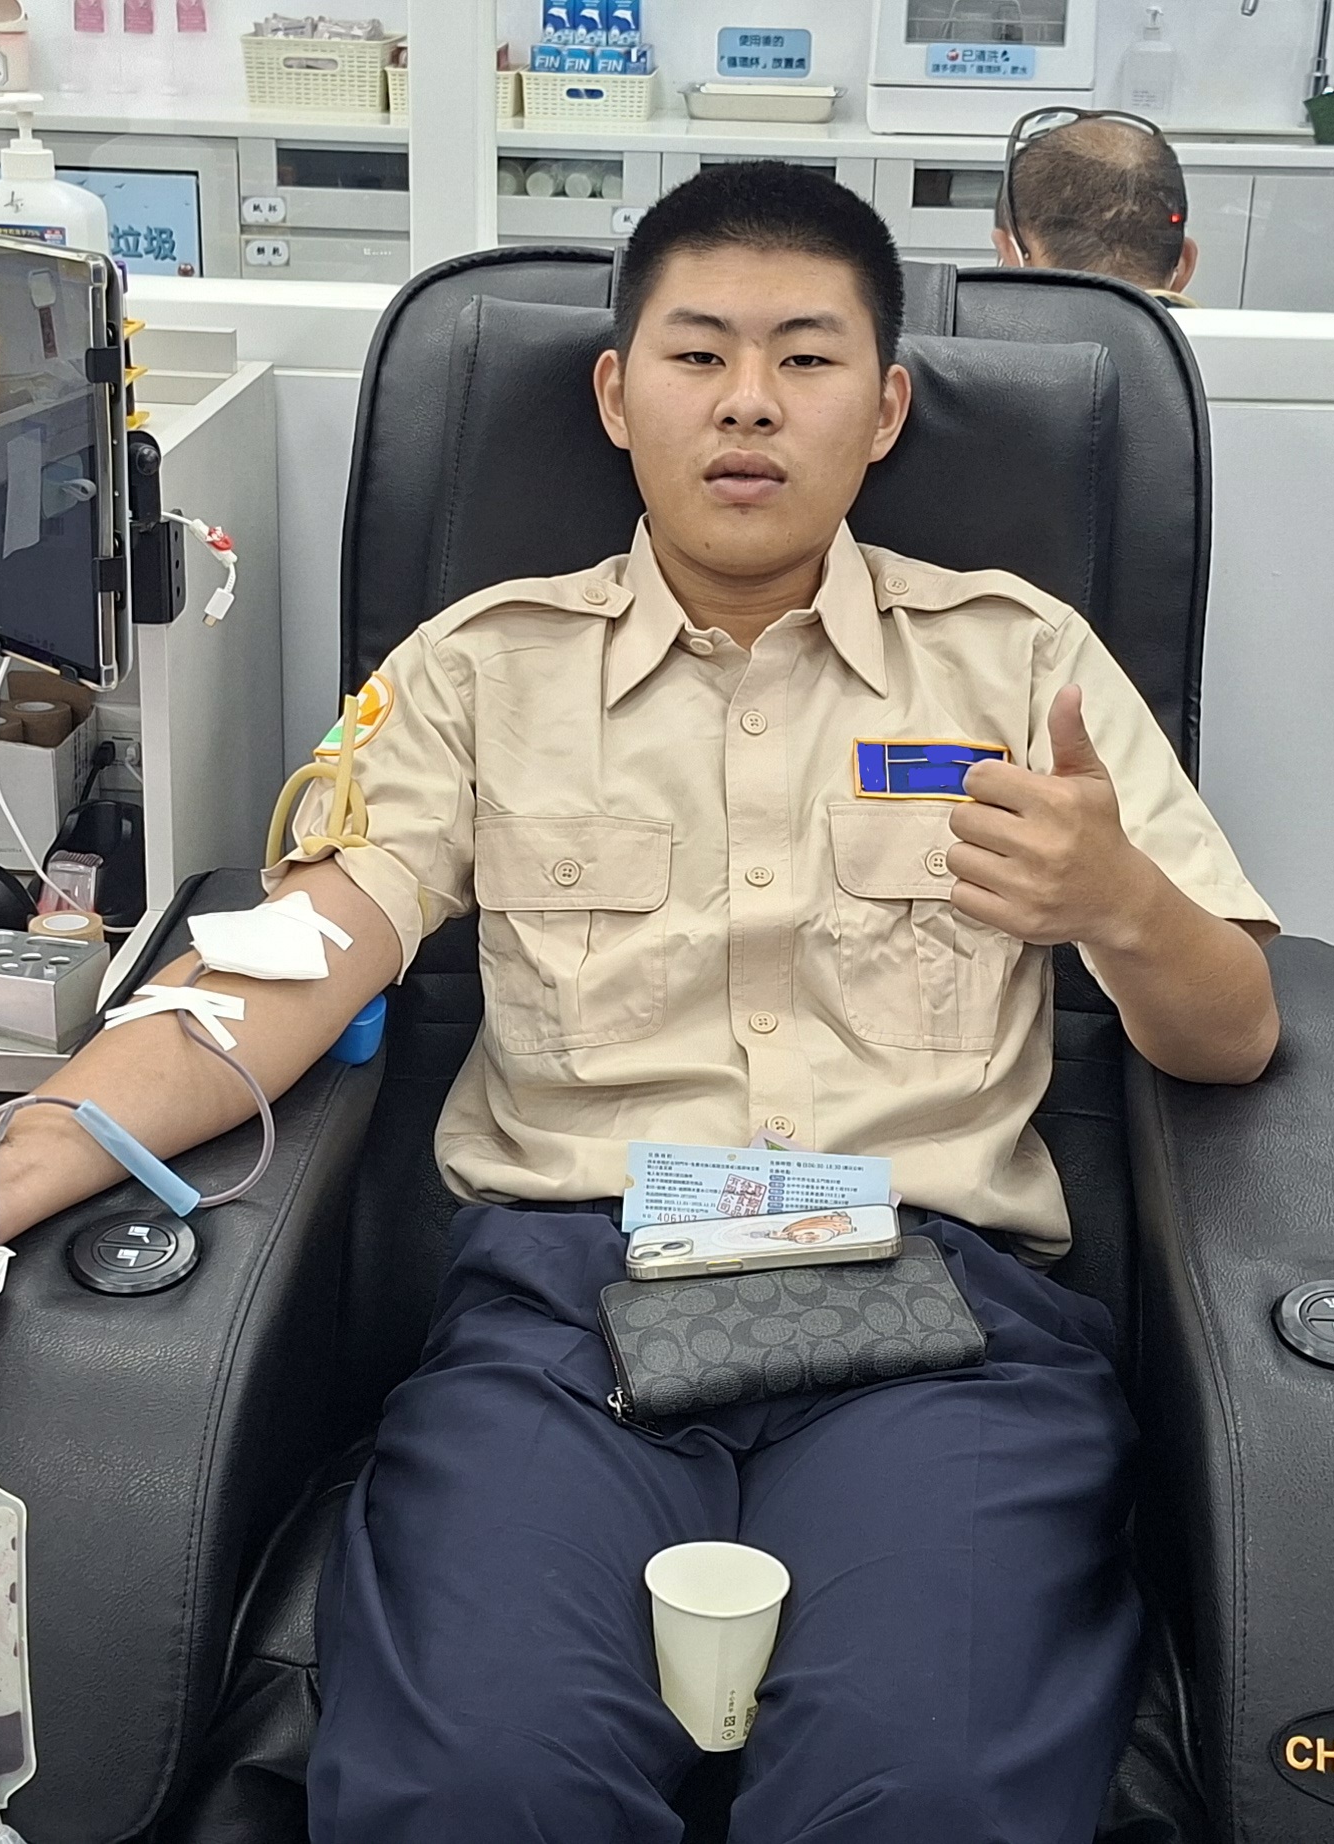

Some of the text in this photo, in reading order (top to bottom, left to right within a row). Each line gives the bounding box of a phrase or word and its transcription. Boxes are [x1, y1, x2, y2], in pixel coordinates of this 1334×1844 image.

[534, 56, 561, 69] FIN
[564, 58, 591, 71] FIN
[597, 59, 623, 72] FIN
[110, 224, 178, 262] 垃圾
